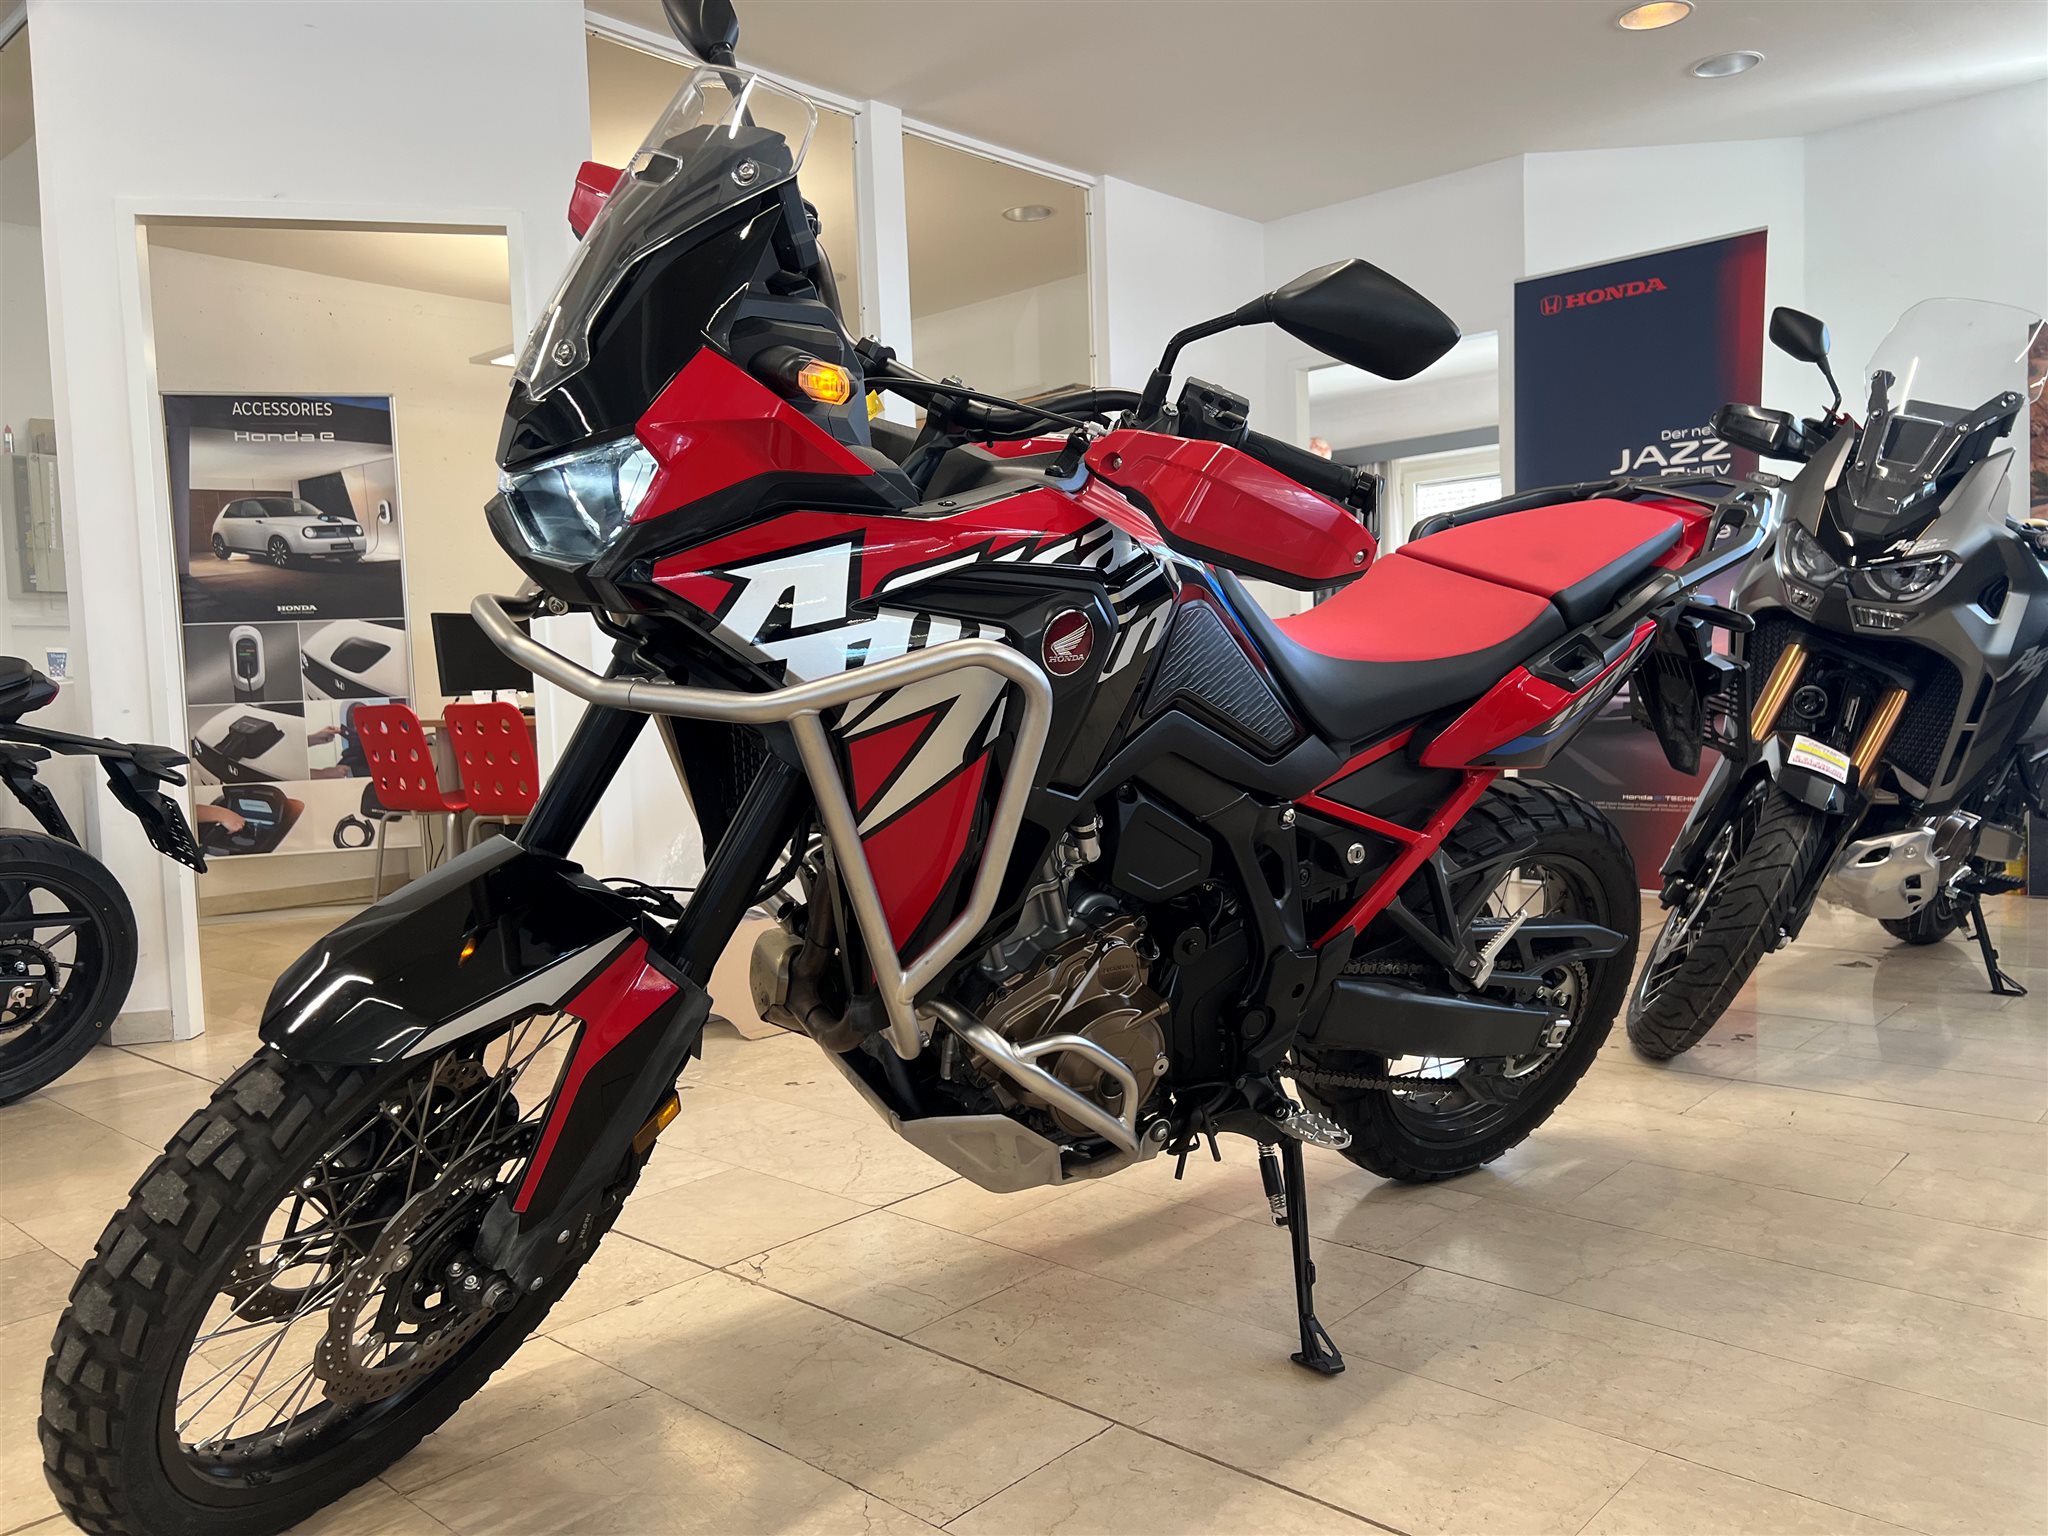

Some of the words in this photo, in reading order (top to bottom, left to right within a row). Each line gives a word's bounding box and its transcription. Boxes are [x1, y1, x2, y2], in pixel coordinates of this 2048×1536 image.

[1565, 278, 1667, 309] HONDA
[232, 402, 333, 416] ACCESSORIES
[234, 431, 315, 442] Honda
[1661, 428, 1689, 440] Der
[1691, 425, 1711, 437] ne
[1610, 438, 1731, 475] JAZZ
[277, 604, 318, 612] HONDA
[1049, 653, 1085, 663] HONDA
